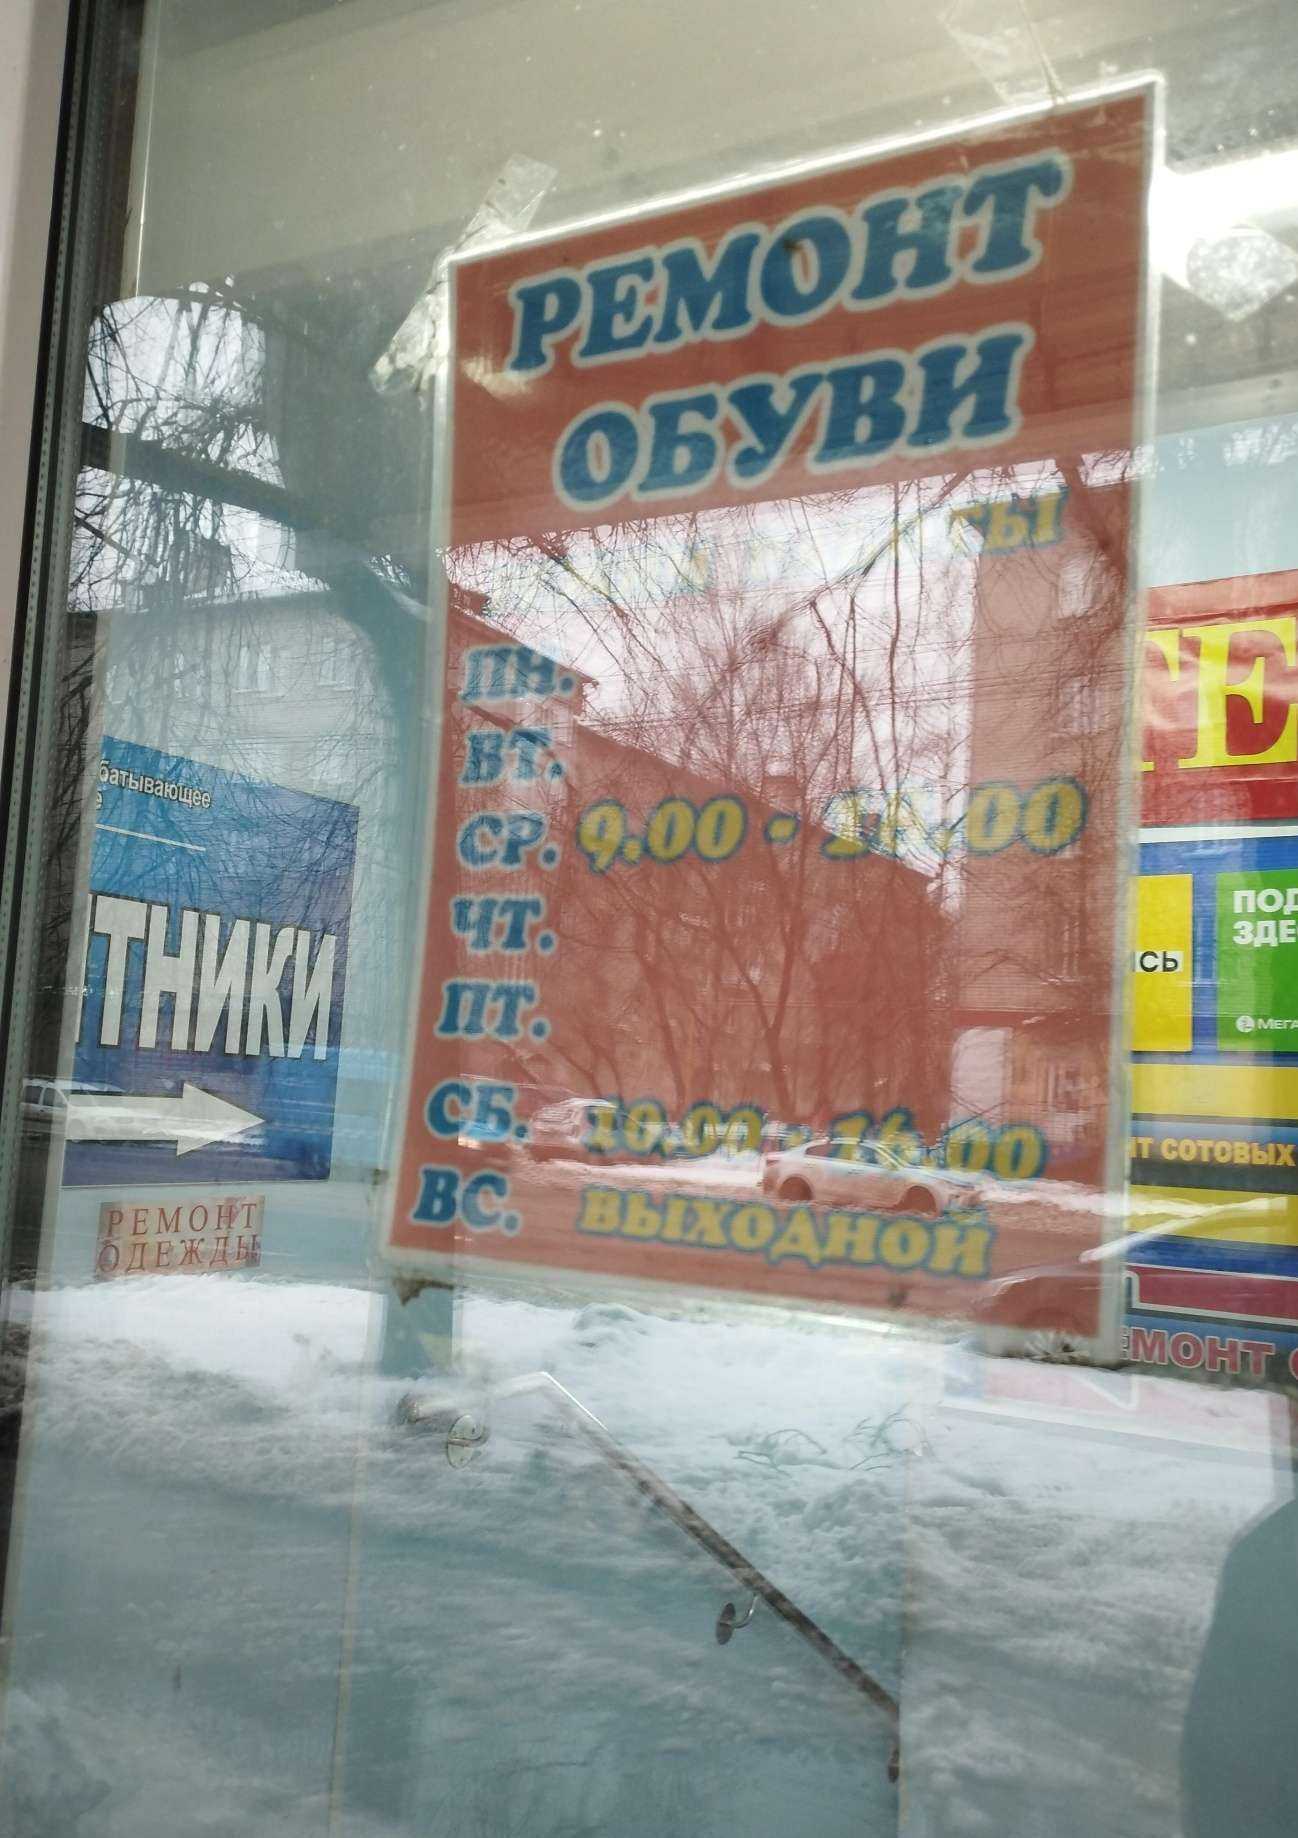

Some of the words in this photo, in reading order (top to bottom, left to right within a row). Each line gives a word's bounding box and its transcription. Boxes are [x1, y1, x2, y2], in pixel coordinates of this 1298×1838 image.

[506, 151, 1073, 378] РЕМОНТ
[554, 324, 1034, 511] ОБУВИ
[461, 645, 576, 704] ПН.
[100, 759, 212, 809] батывающее
[460, 728, 567, 789] ВТ.
[457, 811, 560, 871] СР.
[577, 796, 748, 873] 9.00
[450, 896, 558, 958] ЧТ.
[1232, 919, 1298, 947] ЗДЕ
[76, 890, 337, 1061] ТНИКИ
[1132, 950, 1179, 972] СЬ
[435, 977, 553, 1041] ПТ.
[424, 1080, 531, 1145] СБ.
[1159, 1137, 1297, 1167] СОТОВЫХ
[105, 1203, 258, 1239] РЕМОНТ
[412, 1165, 522, 1234] ВС.
[97, 1233, 260, 1275] ОДЕЖДЫ
